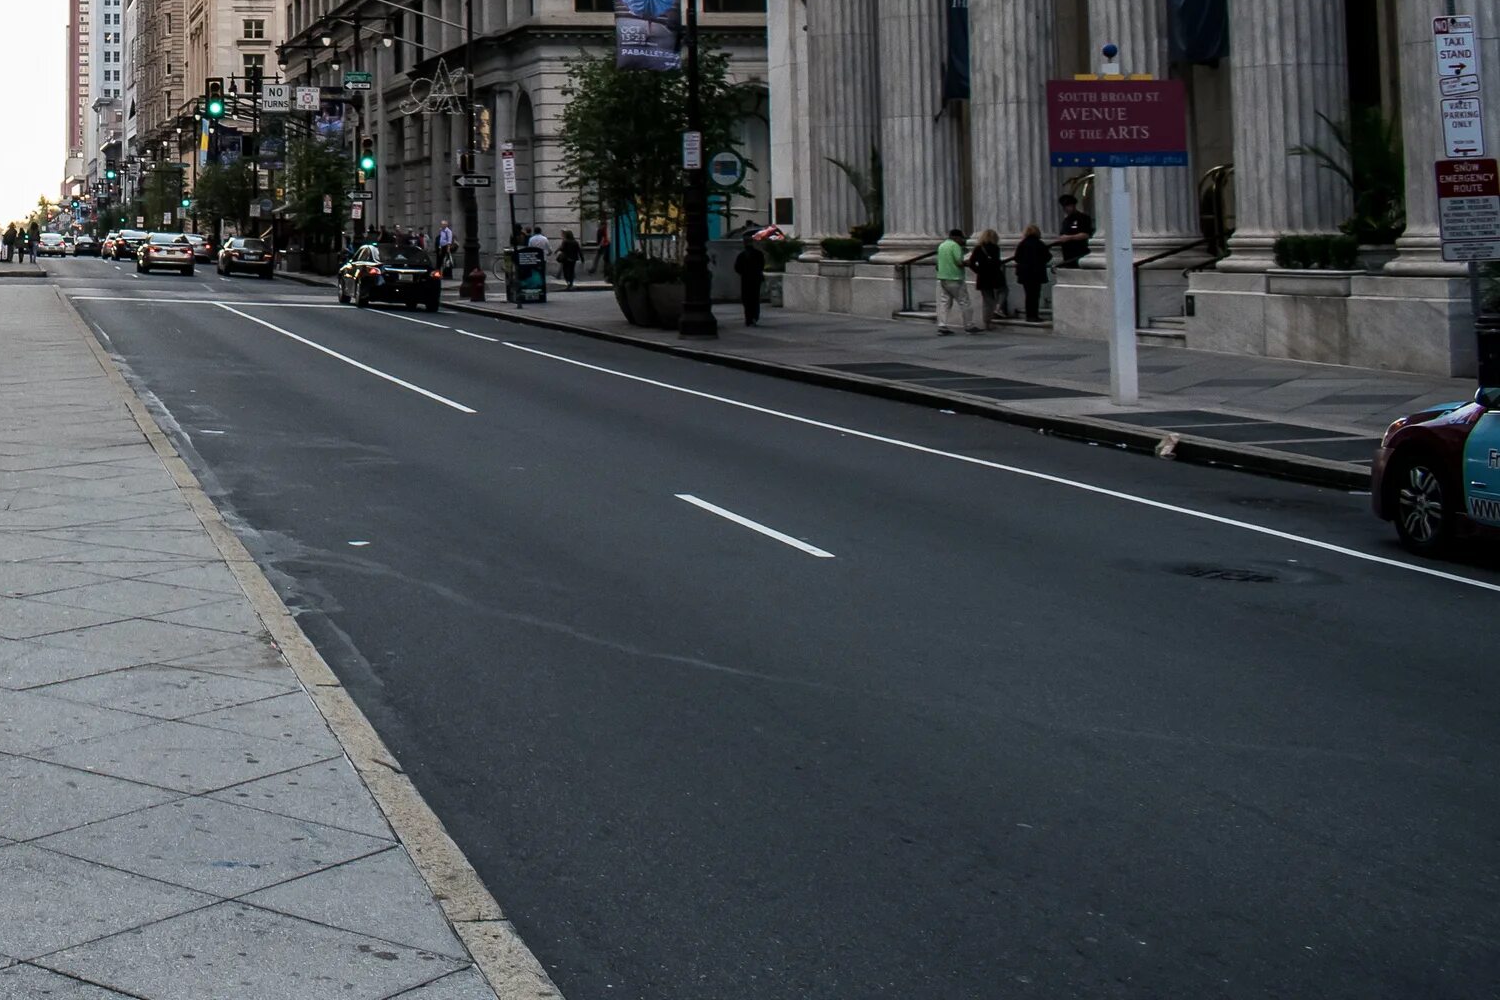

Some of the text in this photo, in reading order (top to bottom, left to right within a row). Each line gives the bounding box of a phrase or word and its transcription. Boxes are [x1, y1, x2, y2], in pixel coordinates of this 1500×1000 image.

[621, 25, 640, 33] OCT
[1435, 20, 1447, 31] NO
[1443, 36, 1465, 46] TAXI
[1440, 49, 1471, 60] STAND
[269, 88, 283, 97] NO
[1058, 92, 1097, 102] SOUTH
[1101, 92, 1142, 102] BROAD
[264, 100, 289, 108] TURNS
[1450, 102, 1472, 110] VALET
[1060, 107, 1128, 120] AVENUE
[1444, 111, 1479, 119] PARKING
[1452, 120, 1472, 128] ONLY
[1060, 126, 1150, 139] OF THE ARTS
[1453, 163, 1480, 173] SNOW
[1439, 173, 1495, 183] EMERGENCY
[1453, 183, 1484, 193] ROUTE
